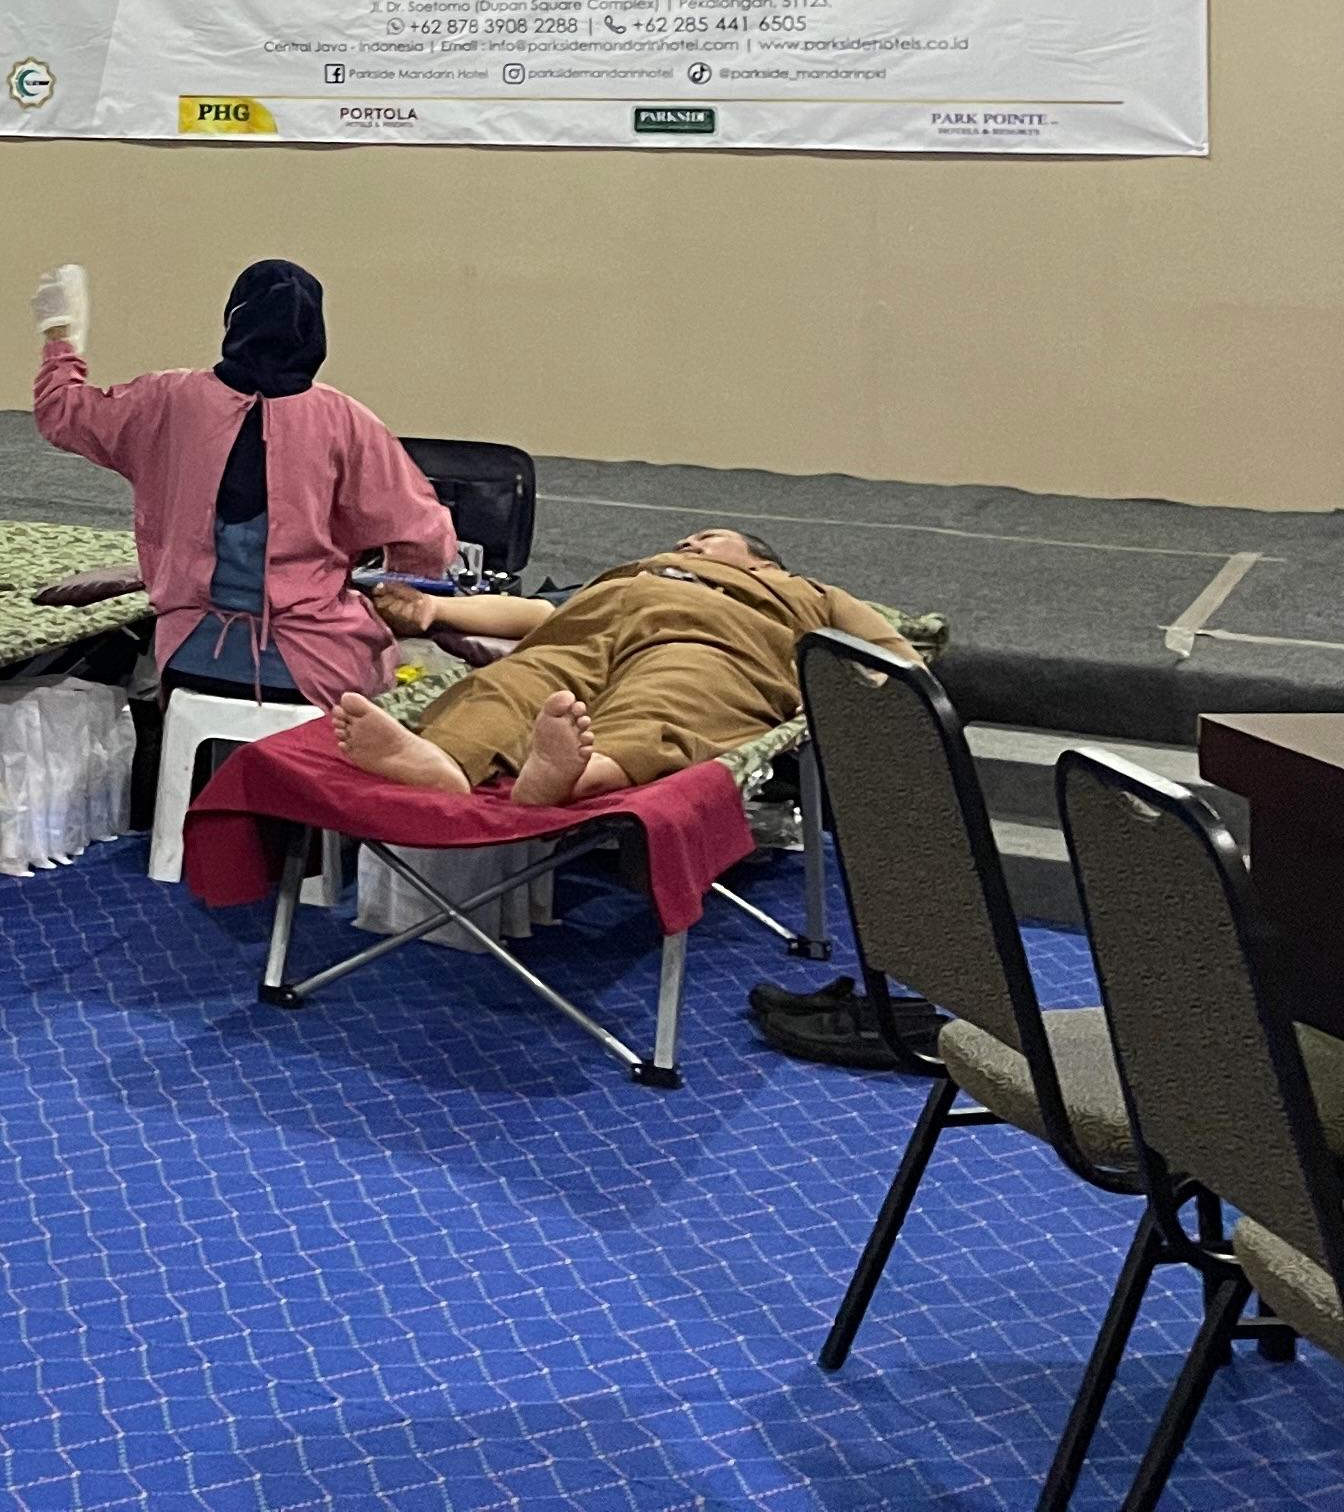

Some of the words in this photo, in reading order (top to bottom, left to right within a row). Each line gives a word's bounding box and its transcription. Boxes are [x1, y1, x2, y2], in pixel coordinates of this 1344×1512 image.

[408, 0, 470, 12] Soetomo
[475, 0, 527, 14] (Dupan
[531, 0, 582, 13] Square
[410, 19, 442, 35] +62
[446, 18, 479, 34] 878
[484, 18, 528, 34] 3908
[534, 17, 578, 34] 2288
[633, 16, 668, 33] +62
[673, 16, 709, 33] 285
[715, 16, 748, 31] 441
[758, 16, 807, 32] 6505
[263, 40, 312, 53] Central
[315, 41, 347, 53] Java
[359, 41, 424, 52] Indonesia
[197, 103, 250, 122] PHG
[339, 107, 418, 120] PORTOLA
[931, 112, 978, 125] PARK
[983, 113, 1048, 125] POINTE
